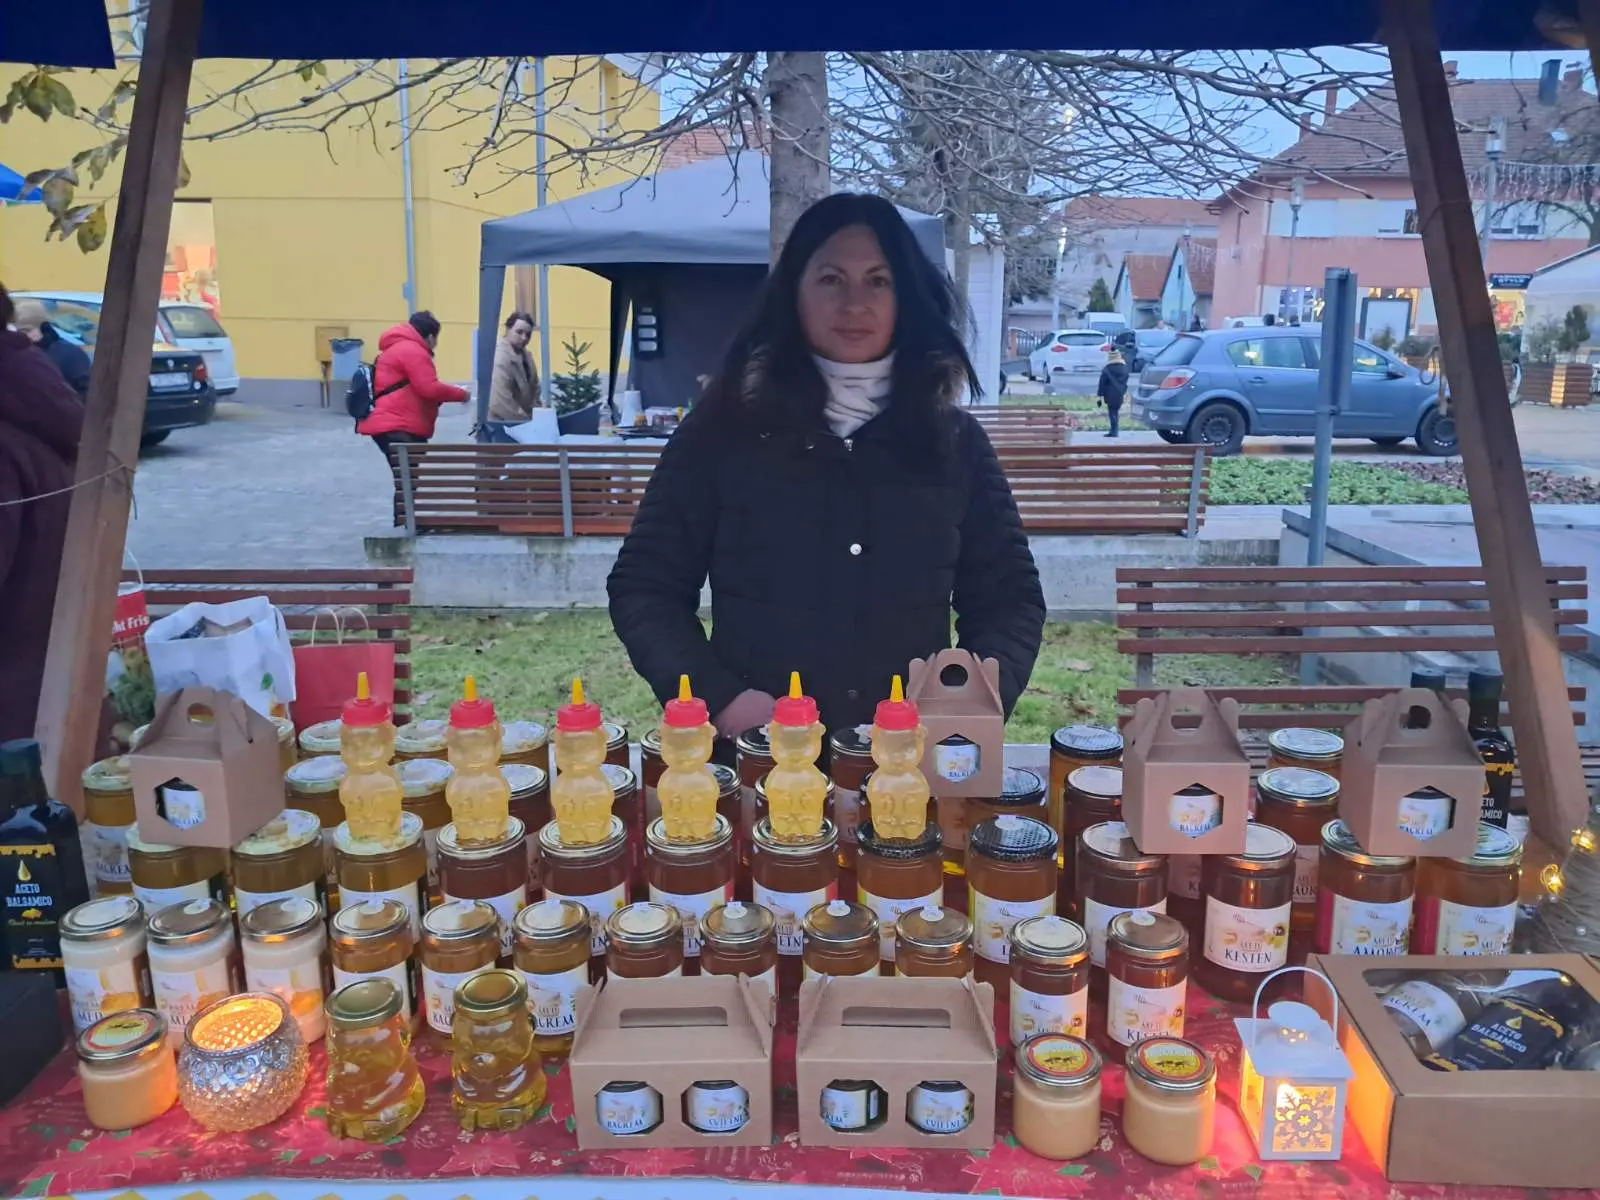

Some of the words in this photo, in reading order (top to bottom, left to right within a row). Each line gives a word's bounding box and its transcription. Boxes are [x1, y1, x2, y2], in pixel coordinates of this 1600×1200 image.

[15, 883, 40, 894] ACETO
[6, 896, 53, 907] BALSAMICO
[1225, 947, 1272, 964] KESTEN
[1471, 1023, 1527, 1053] BALSAMICO
[1491, 1023, 1522, 1040] ACETO
